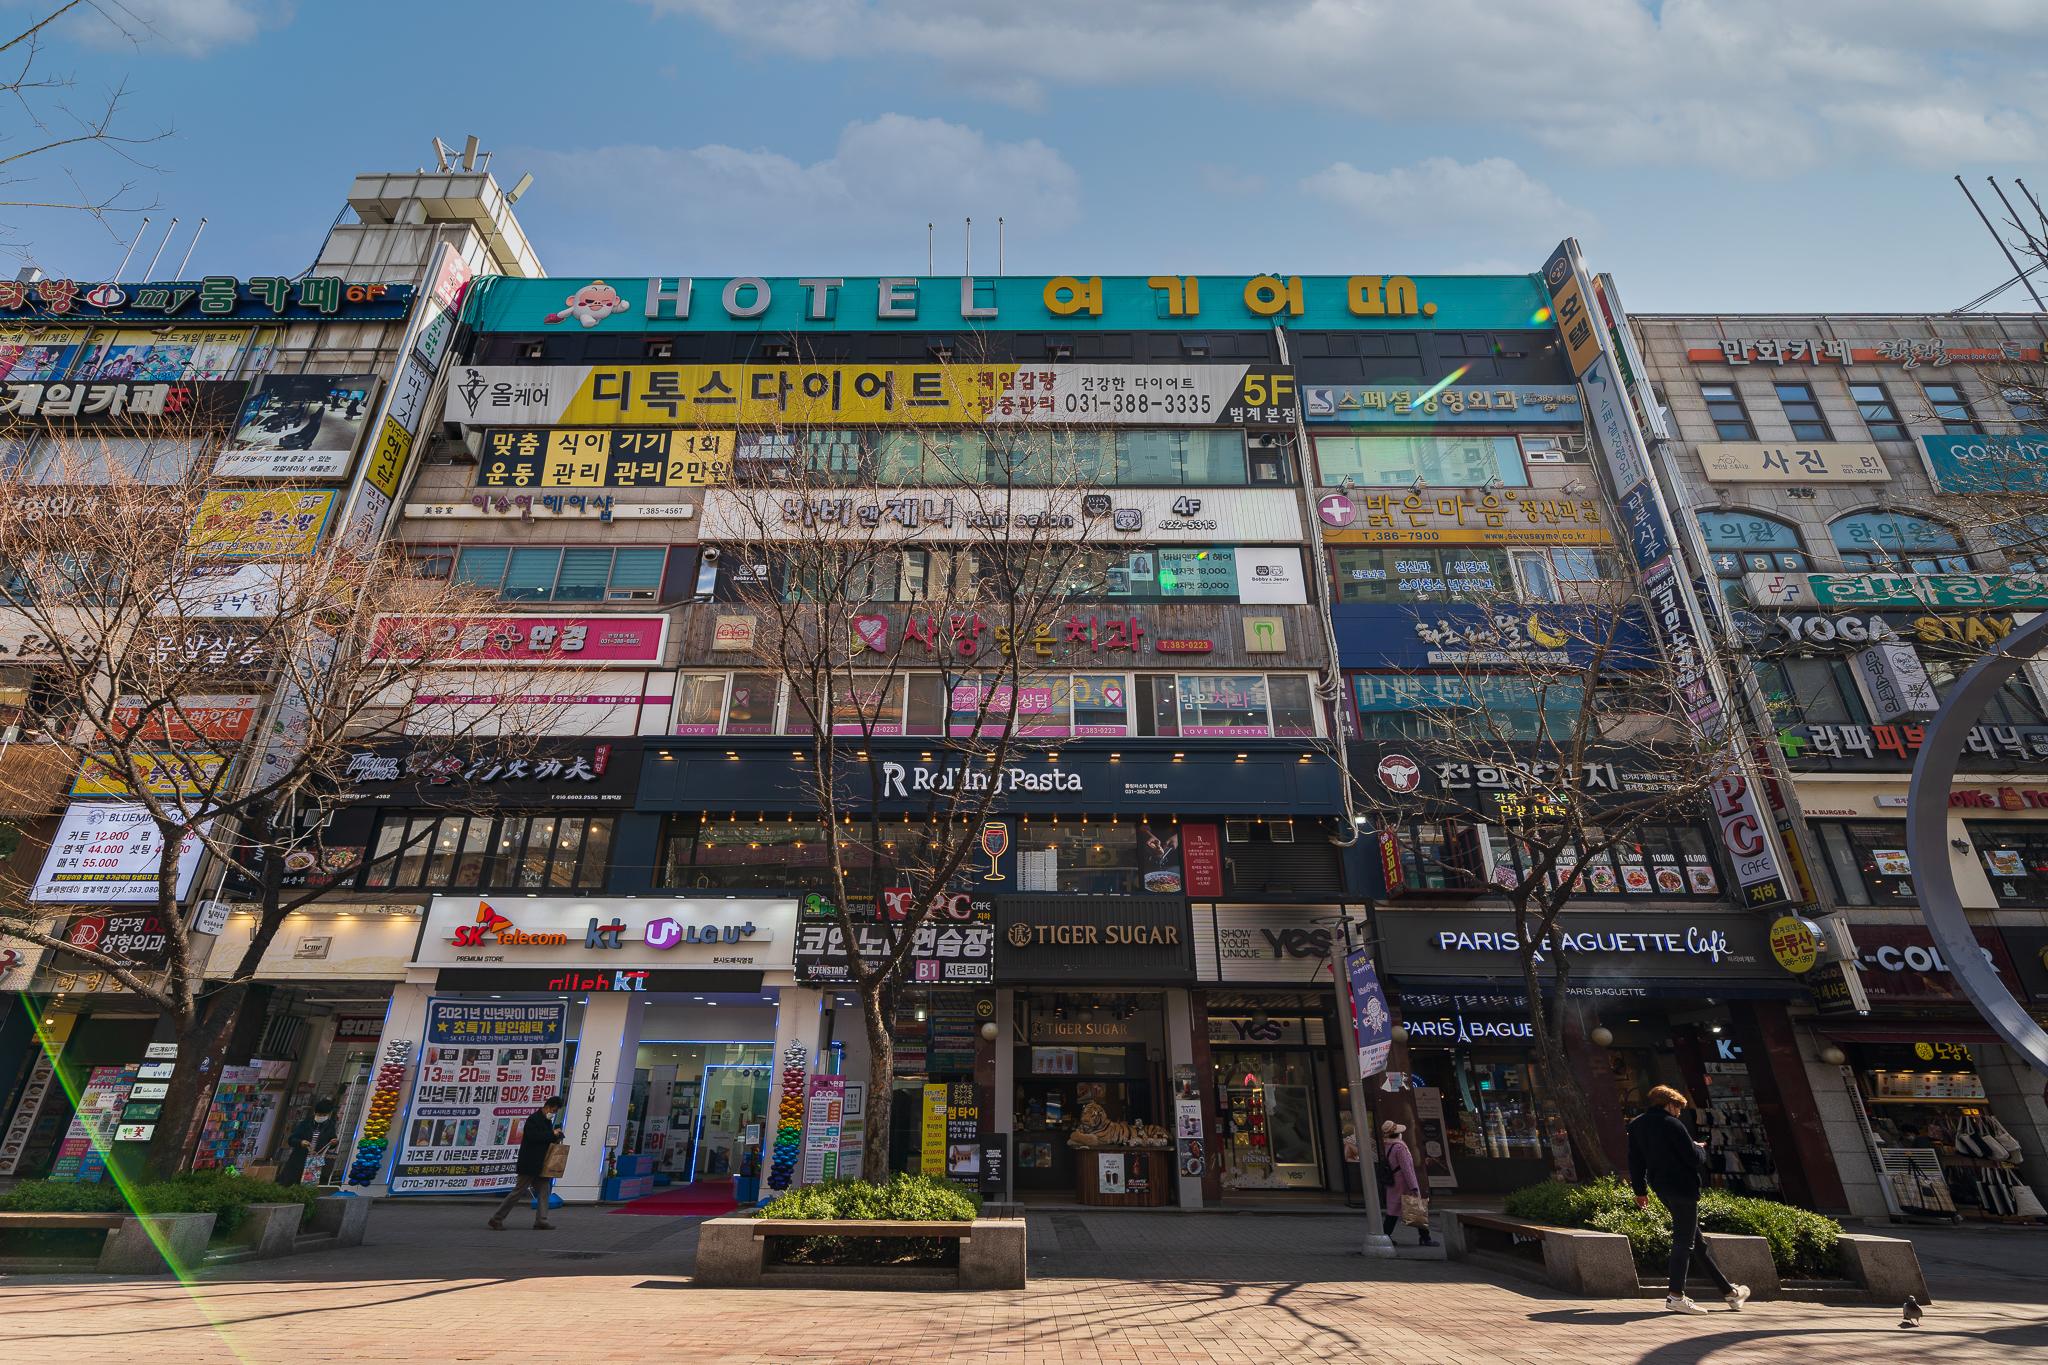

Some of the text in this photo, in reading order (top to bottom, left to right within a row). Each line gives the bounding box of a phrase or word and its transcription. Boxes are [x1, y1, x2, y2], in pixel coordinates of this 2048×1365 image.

[346, 285, 388, 302] 6F
[644, 277, 999, 319] HOTEL
[1560, 293, 1591, 352] 호텔
[1721, 338, 1853, 366] 만화카페
[977, 372, 1057, 391] 책임감량
[1081, 376, 1195, 391] 건강한 다이어트
[1244, 374, 1294, 406] 5F
[491, 382, 549, 407] 올케어
[592, 370, 950, 418] 디톡스다이어트
[1066, 393, 1211, 414] 031-388-3335
[1230, 407, 1295, 424] 범계 본점
[493, 433, 540, 455] 맞춤
[558, 433, 605, 455] 식이
[618, 433, 666, 455] 기기
[687, 435, 720, 454] 1회
[1762, 450, 1829, 474] 사진
[1860, 457, 1880, 468] B1
[486, 464, 534, 487] 운동
[552, 463, 600, 484] 관리
[614, 462, 662, 483] 관리
[669, 461, 731, 482] 2만원
[543, 495, 616, 523] 헤어샵
[1173, 496, 1201, 516] 4F
[1366, 495, 1509, 527] 밝은마음
[1520, 500, 1579, 523] 정신과
[966, 511, 1008, 528] Hair
[1014, 511, 1074, 528] salon
[1159, 520, 1217, 530] 422-5313
[1362, 531, 1440, 541] T.386-7900
[1196, 567, 1227, 576] 18,000
[1395, 561, 1431, 574] 정신과
[1196, 581, 1230, 590] 20,000
[528, 626, 588, 651] 안경
[1776, 615, 2014, 645] YOGA STAY
[1162, 640, 1209, 650] T.383-0223
[236, 698, 252, 706] 3F
[1020, 694, 1048, 709] 상담
[1080, 727, 1116, 735] T.383-0223
[1008, 767, 1083, 791] Pasta
[1711, 775, 1765, 858] PC
[68, 831, 129, 841] 커트 12.000
[141, 831, 151, 842] 펌
[63, 845, 124, 855] 염색 44.000
[129, 845, 151, 855] 셋팅
[1651, 854, 1675, 862] 10.000
[1684, 854, 1707, 863] 14.000
[57, 858, 118, 868] 매직 55.000
[1741, 858, 1771, 876] CAFE
[1751, 883, 1777, 902] 지하
[971, 901, 991, 910] CAFE
[977, 912, 991, 920] 지하
[109, 918, 145, 932] 압구정
[585, 917, 627, 949] kt
[686, 921, 757, 944] LG U+
[1220, 929, 1250, 938] SHOW
[451, 924, 567, 948] SK telecom
[1035, 924, 1180, 945] TIGER SUGAR
[101, 935, 166, 954] 성형외과
[1222, 940, 1250, 949] YOUR
[1440, 932, 1520, 951] PARIS
[1687, 927, 1734, 963] Café
[1772, 932, 1814, 960] 부동산
[456, 955, 505, 963] PREMIUM STORE
[1223, 949, 1260, 959] UNIQUE
[919, 962, 937, 977] B1
[1595, 988, 1647, 997] BAGUETTE
[438, 1007, 559, 1020] 2021년 신년맞이 이벤트
[453, 1021, 543, 1034] 초특가 할인혜택
[1046, 1022, 1128, 1035] TIGER SUGAR
[1403, 1022, 1456, 1036] PARIS
[424, 1067, 454, 1082] 13만원
[459, 1067, 491, 1082] 20만원
[588, 1050, 602, 1104] PREMIUM
[418, 1085, 556, 1104] 신년특가 최대 90% 할인
[134, 1126, 145, 1137] 꽃
[581, 1106, 593, 1146] STORE
[407, 1150, 479, 1162] 키즈폰 어르신폰
[402, 1178, 468, 1188] 070-7817-6220
